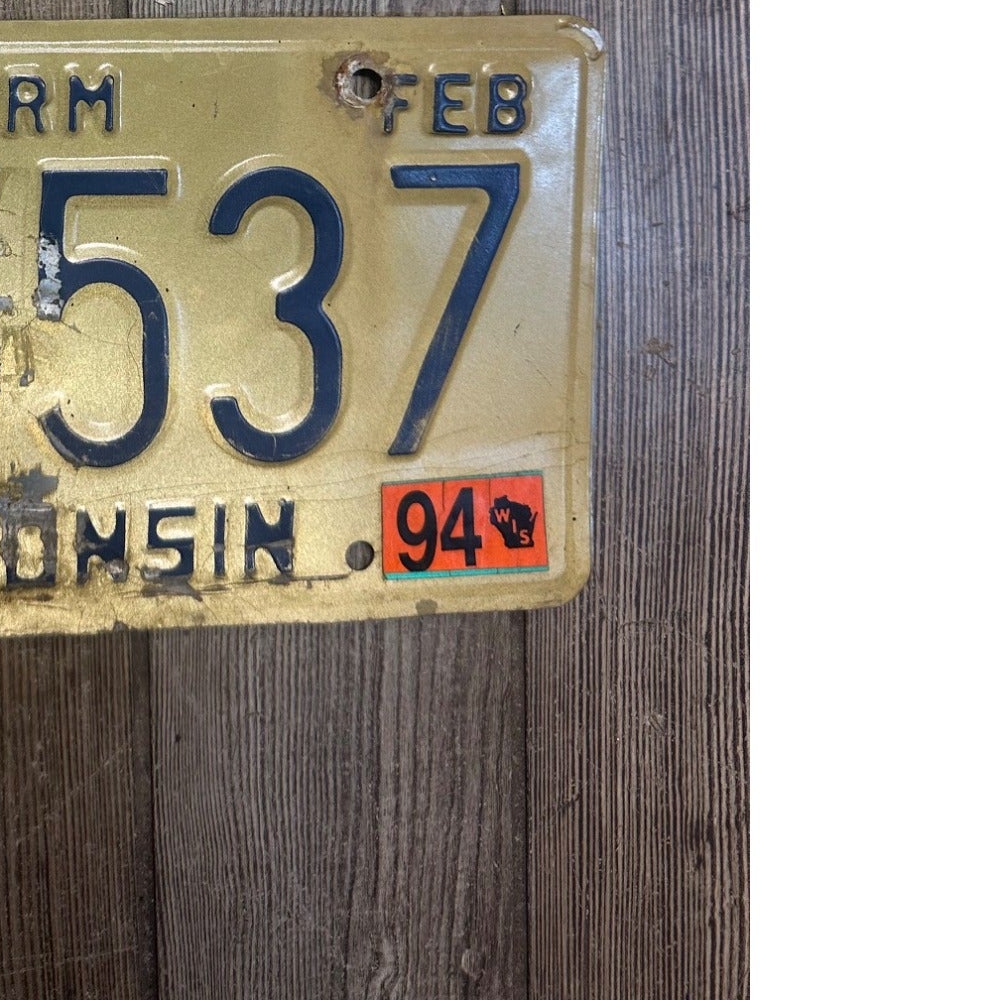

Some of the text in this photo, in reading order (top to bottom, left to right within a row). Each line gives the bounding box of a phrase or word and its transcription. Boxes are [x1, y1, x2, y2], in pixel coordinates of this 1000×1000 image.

[379, 72, 530, 135] FEB
[395, 486, 532, 575] 94 WIS
